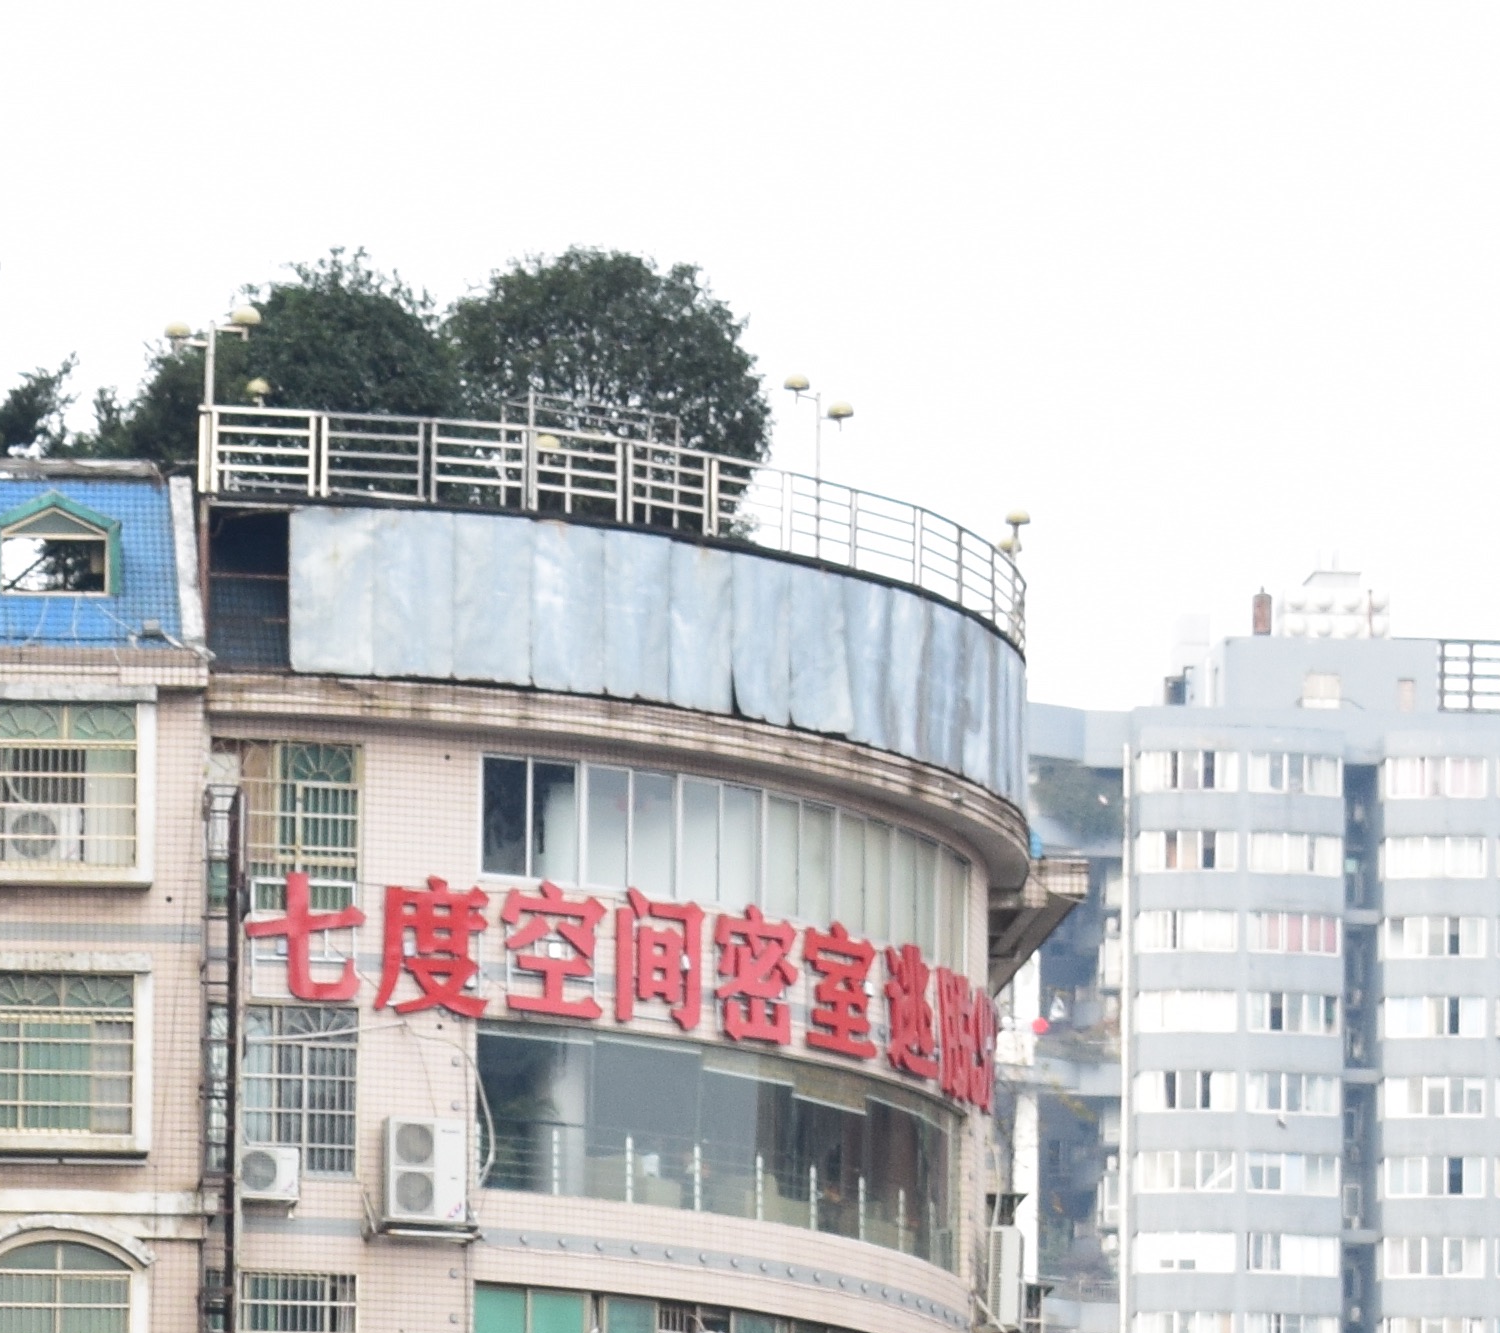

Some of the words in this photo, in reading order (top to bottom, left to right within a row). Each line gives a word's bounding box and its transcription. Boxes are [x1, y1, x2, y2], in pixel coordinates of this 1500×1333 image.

[244, 871, 996, 1114] 七度空间密室逃脱
